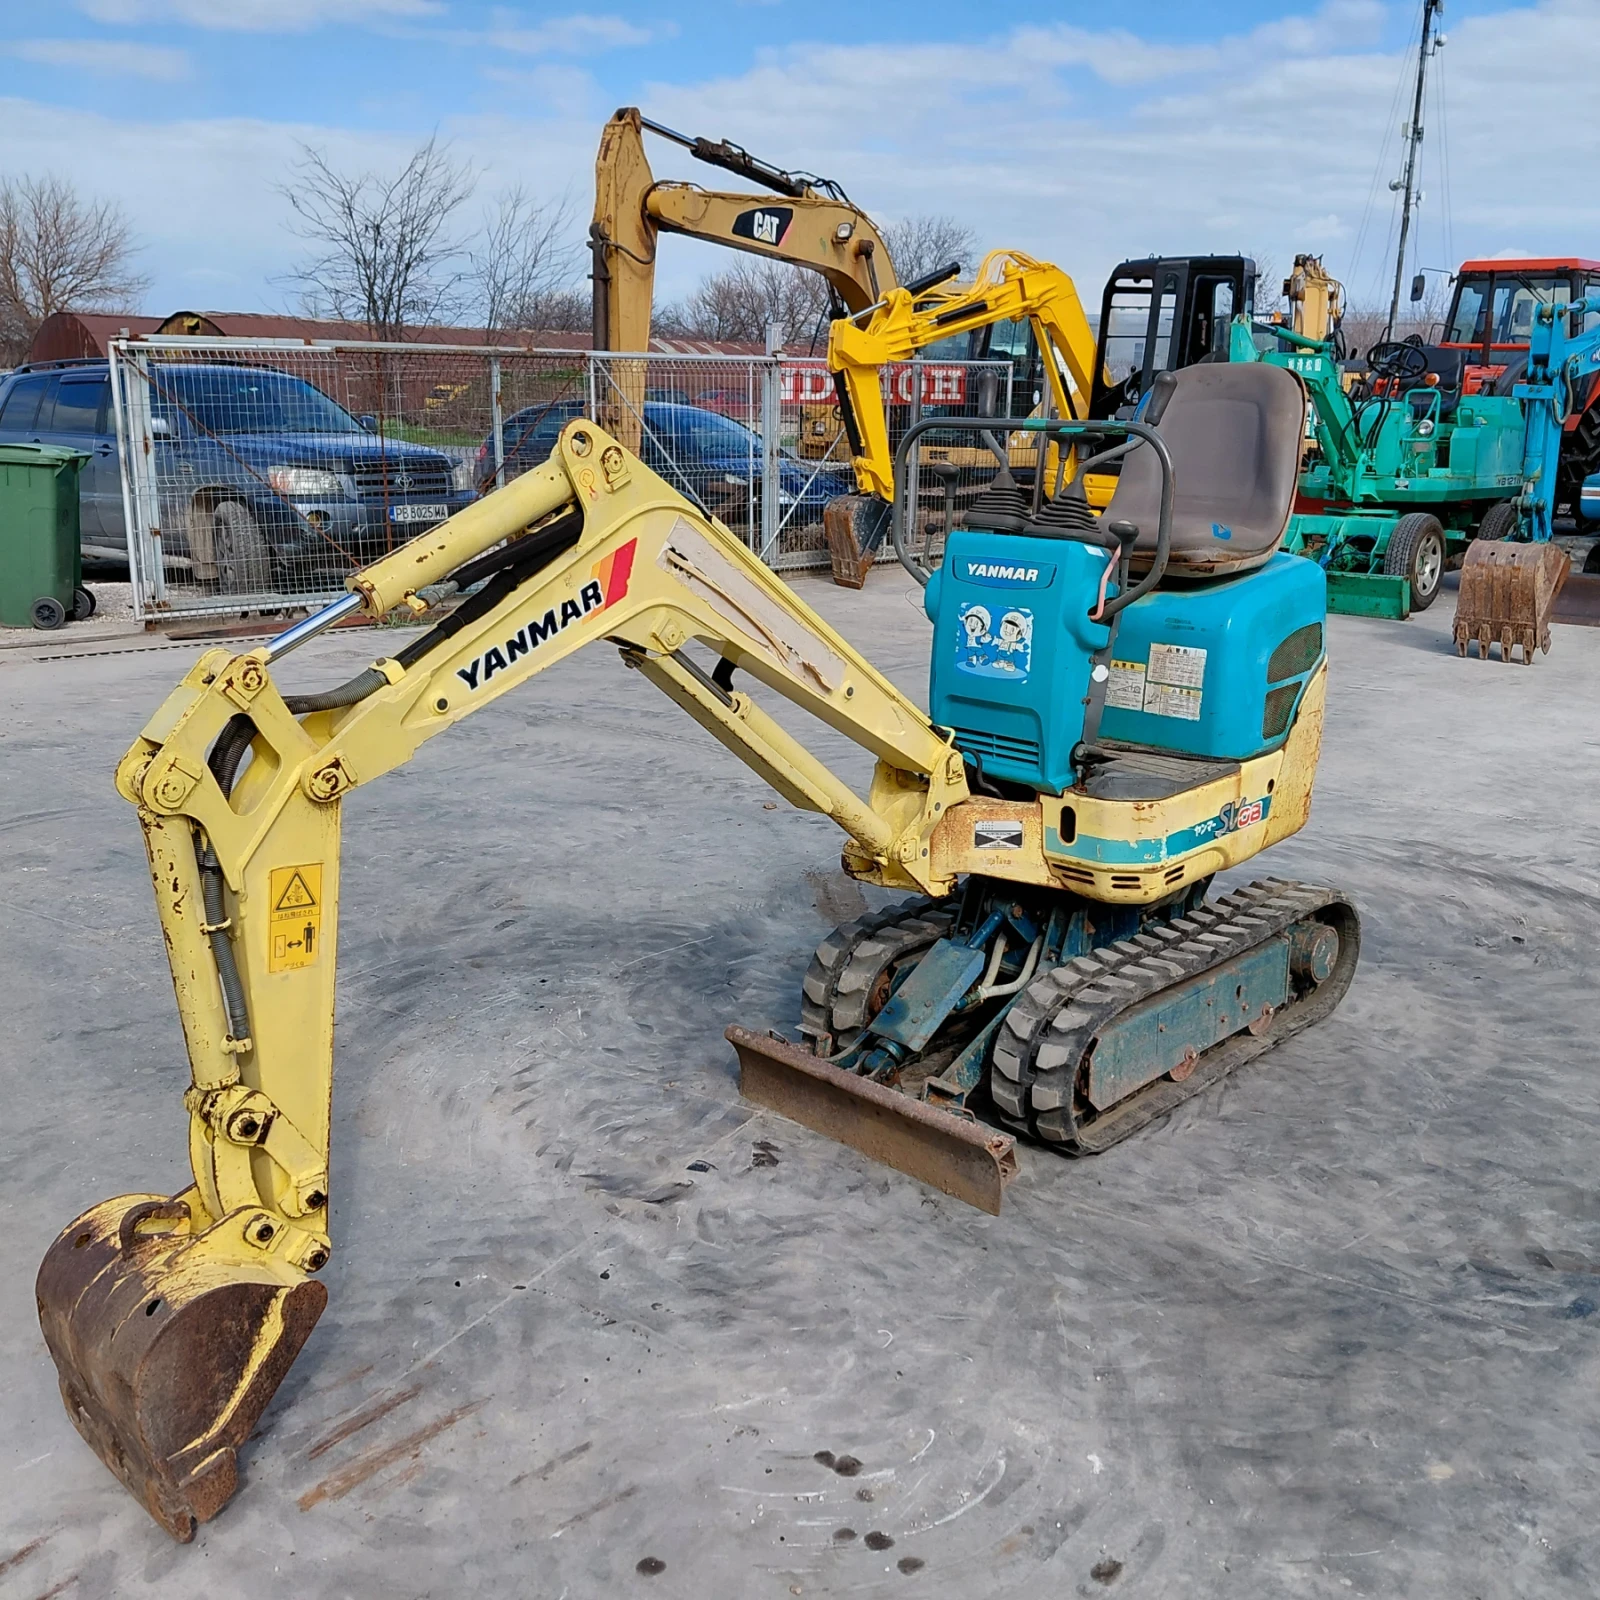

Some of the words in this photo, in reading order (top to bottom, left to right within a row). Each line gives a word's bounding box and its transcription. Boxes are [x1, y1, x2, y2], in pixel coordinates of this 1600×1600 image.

[753, 211, 779, 243] CAT
[410, 506, 433, 519] 8025
[967, 563, 1038, 582] YANMAR
[456, 580, 603, 691] YANMAR
[1194, 820, 1217, 837] ヤンマー
